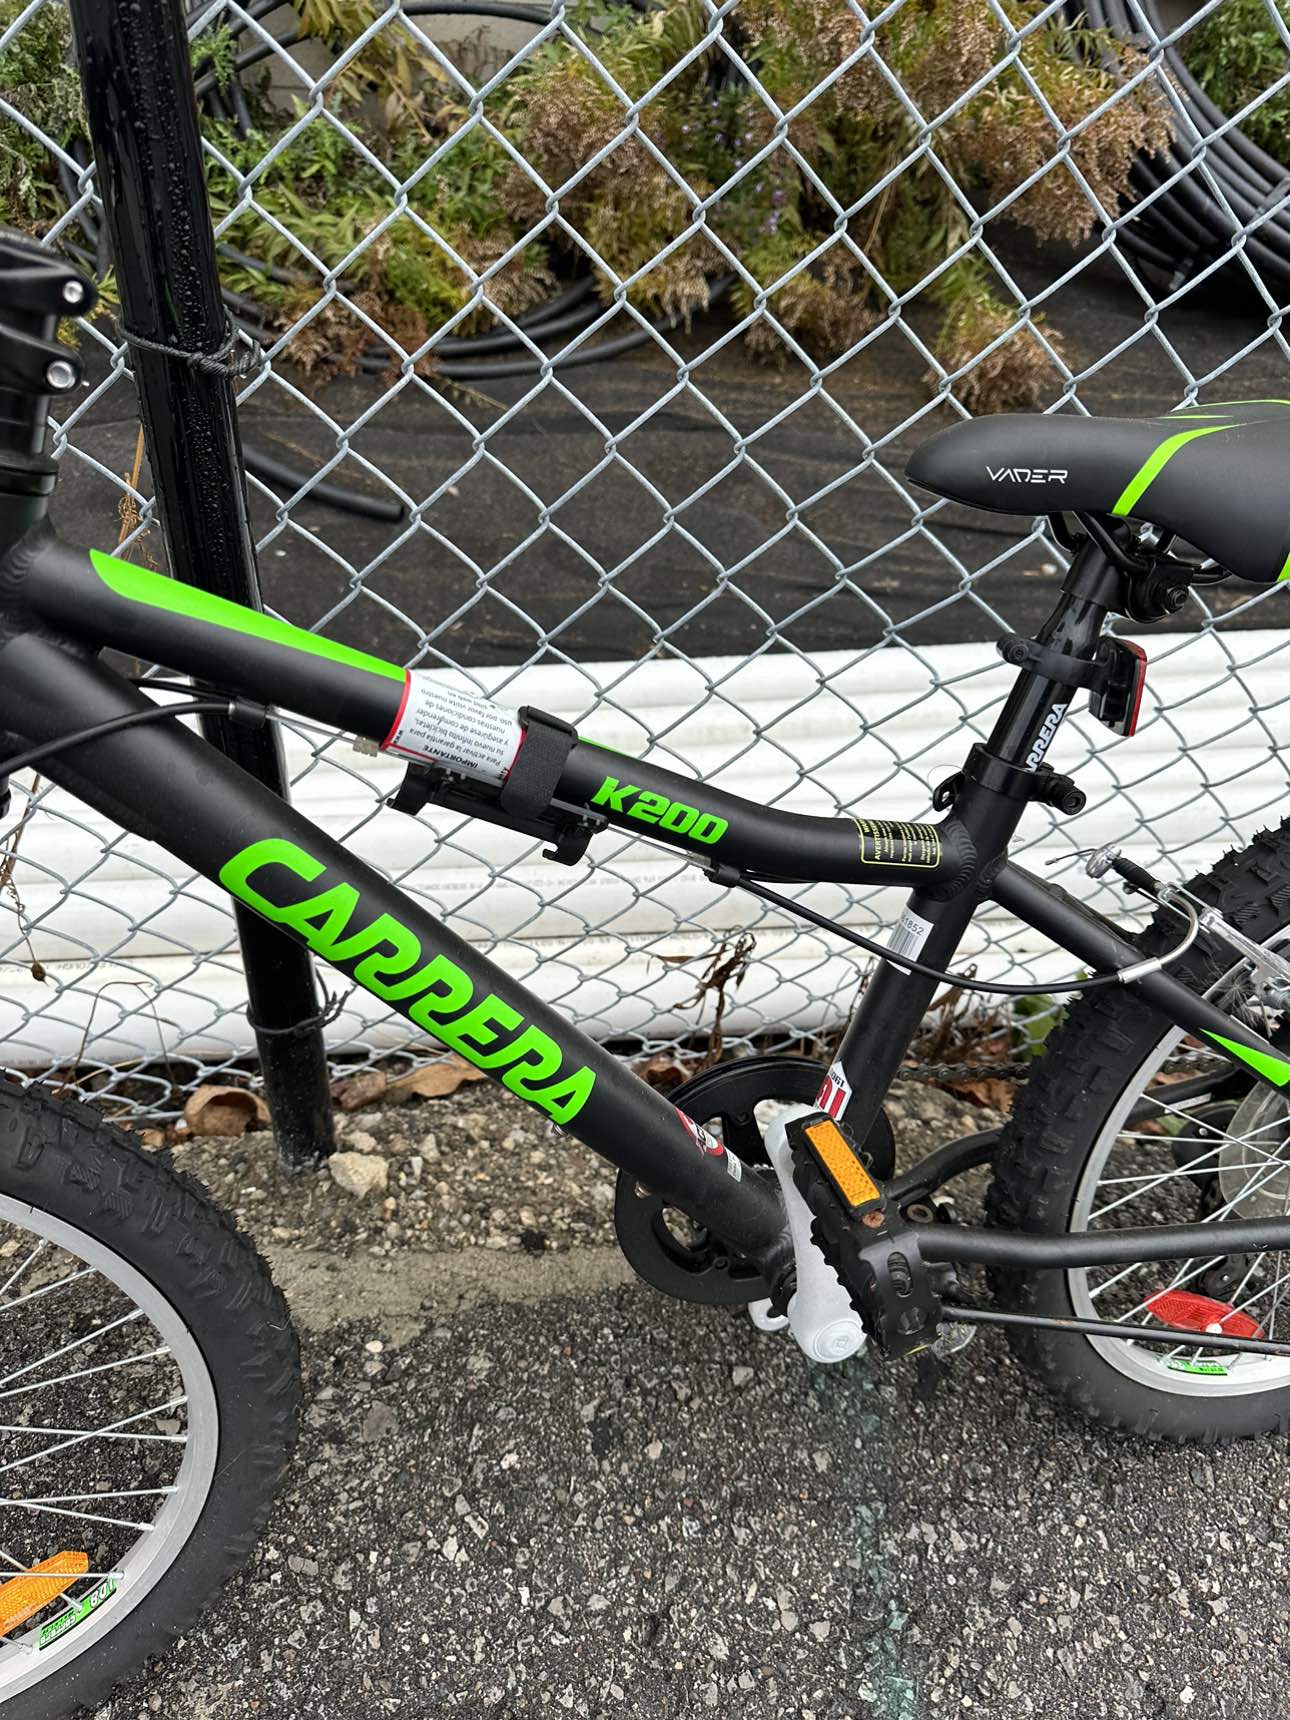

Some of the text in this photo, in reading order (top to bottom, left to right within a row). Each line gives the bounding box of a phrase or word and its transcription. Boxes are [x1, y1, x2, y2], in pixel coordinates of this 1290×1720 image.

[986, 466, 1068, 484] VADER
[435, 704, 476, 723] condiciones
[409, 727, 424, 737] para
[476, 720, 504, 734] nuestras
[462, 747, 485, 760] activar
[474, 741, 495, 752] nuevo
[423, 744, 477, 768] IMPORTANTE
[485, 756, 500, 766] Para
[591, 776, 729, 845] K200
[219, 838, 597, 1125] CARRERA
